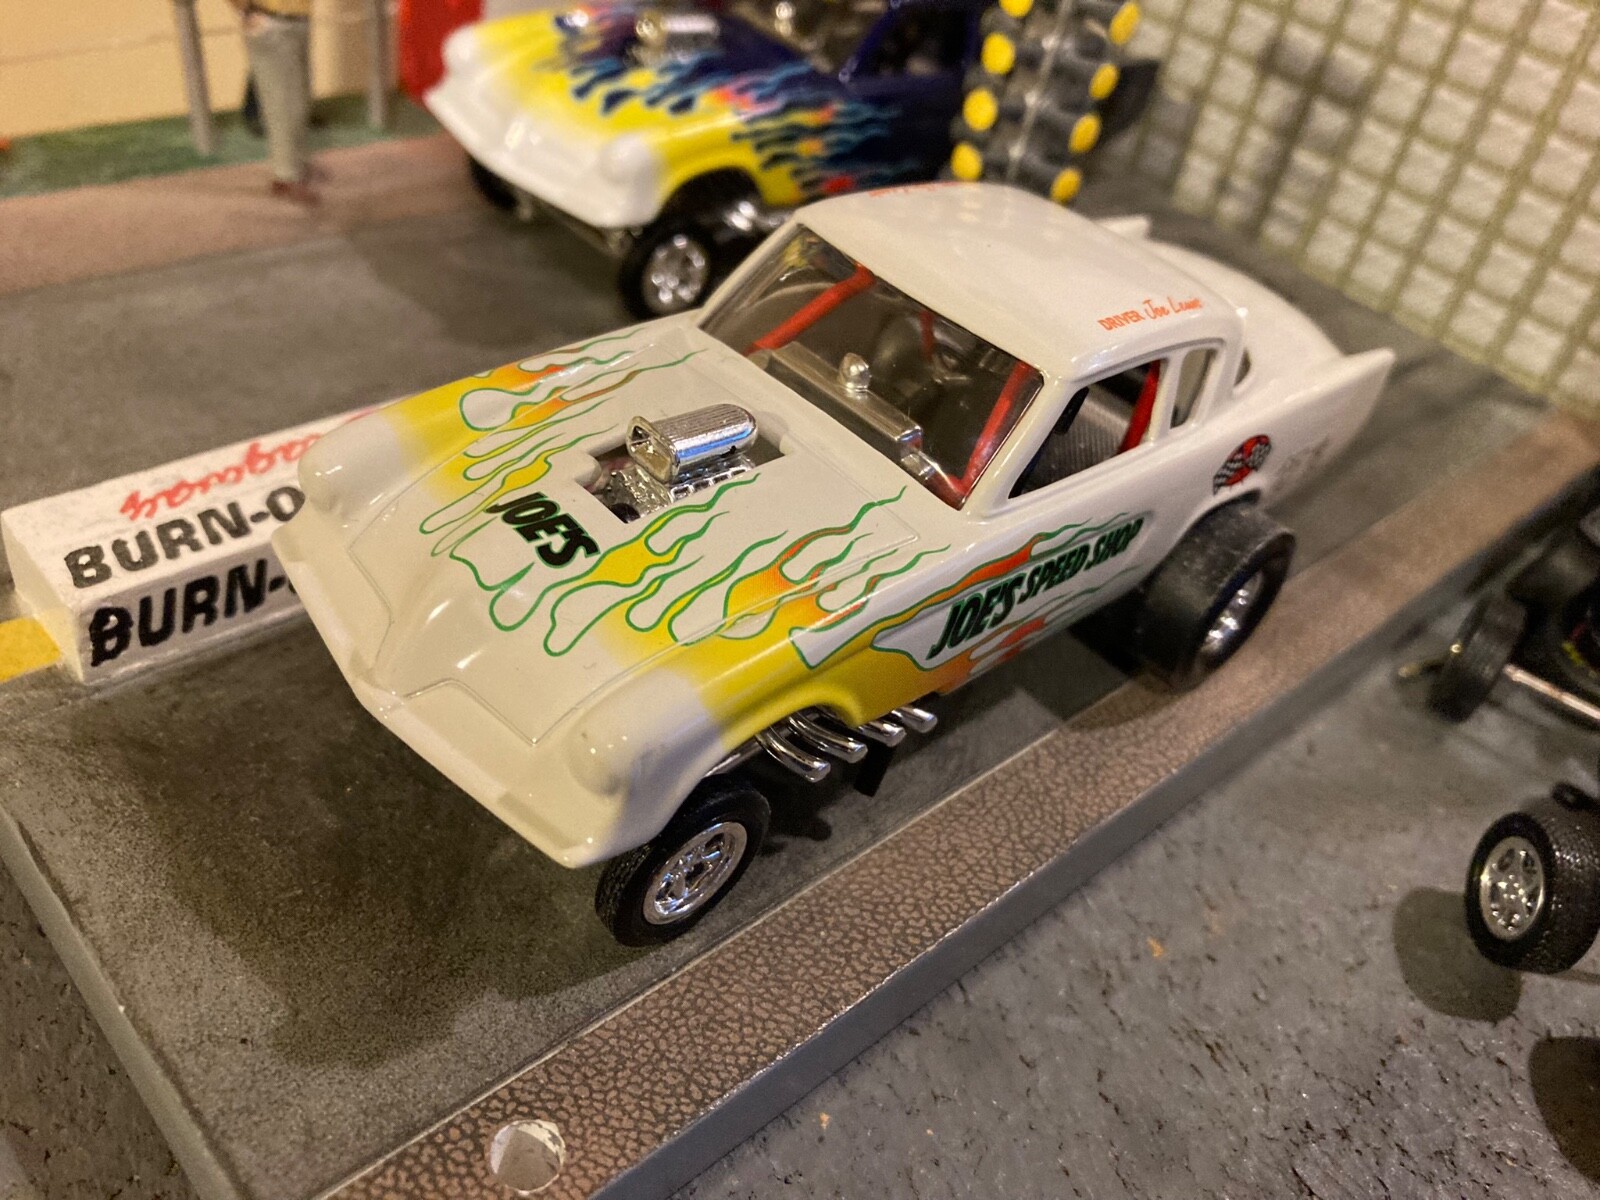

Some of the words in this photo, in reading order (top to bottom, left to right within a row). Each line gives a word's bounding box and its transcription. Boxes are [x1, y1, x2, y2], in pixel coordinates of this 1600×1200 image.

[1097, 310, 1145, 331] DRIVER
[1143, 299, 1170, 320] Joe
[484, 491, 600, 568] JOE'S
[89, 558, 297, 667] BURN-
[926, 572, 1029, 660] JOE'S
[1017, 543, 1091, 605] SPEED
[1084, 517, 1145, 570] SHOP
